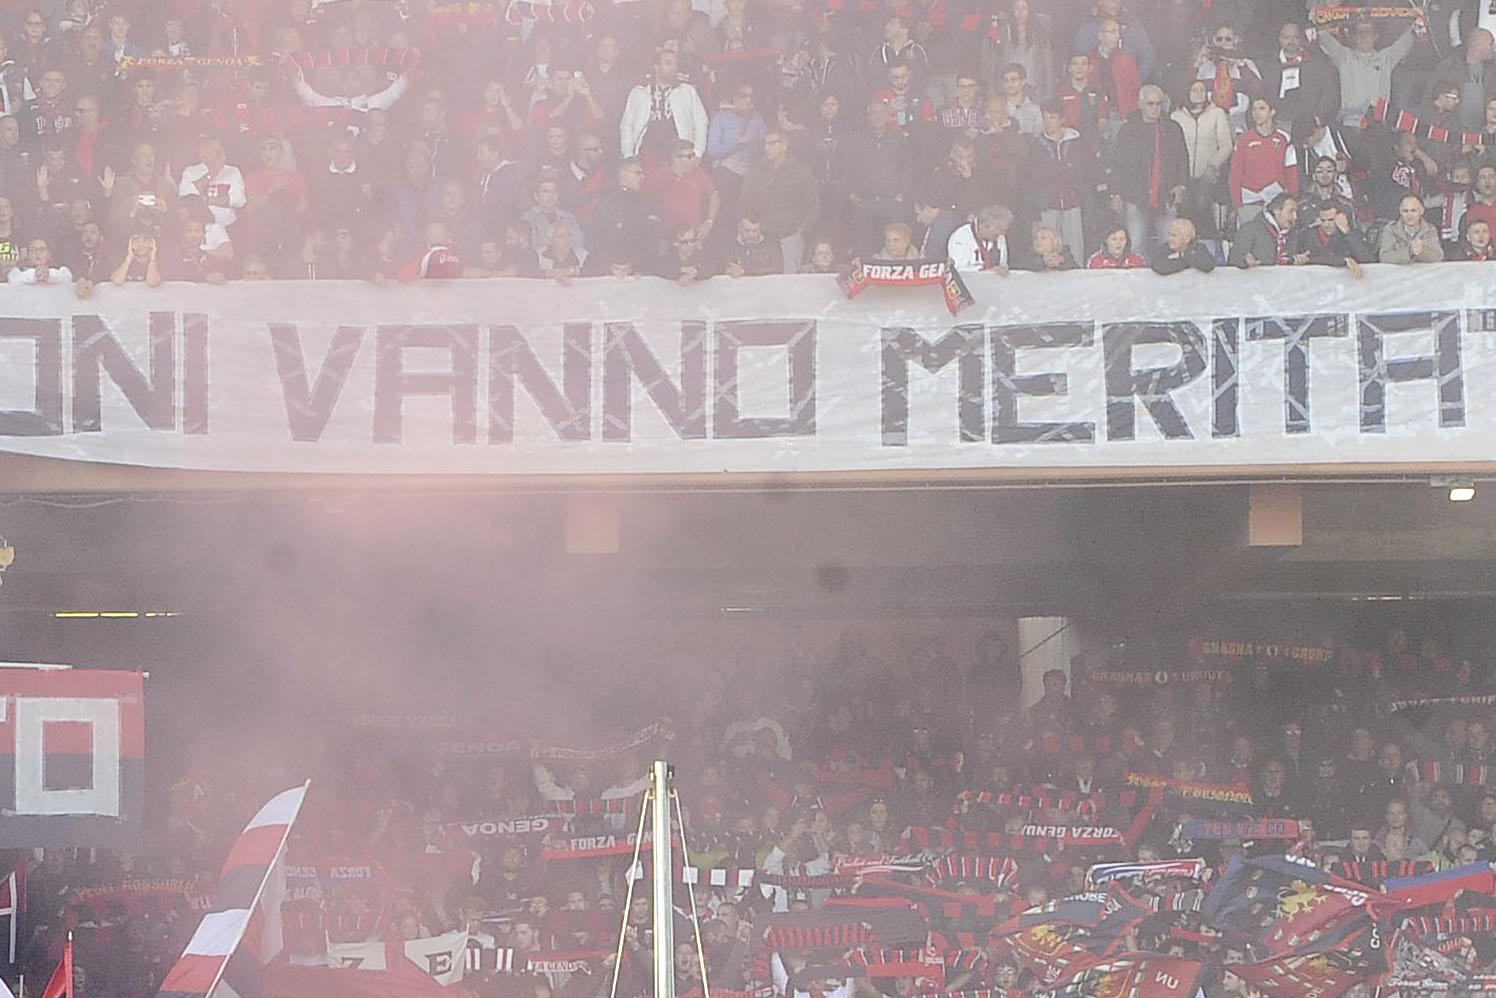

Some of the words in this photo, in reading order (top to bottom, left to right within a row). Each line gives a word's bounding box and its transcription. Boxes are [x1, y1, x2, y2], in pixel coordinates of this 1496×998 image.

[862, 264, 915, 280] FORZA
[267, 317, 817, 446] VANNO
[880, 311, 1496, 447] MERITA
[462, 819, 549, 836] GENOA
[570, 836, 616, 851] FORZA
